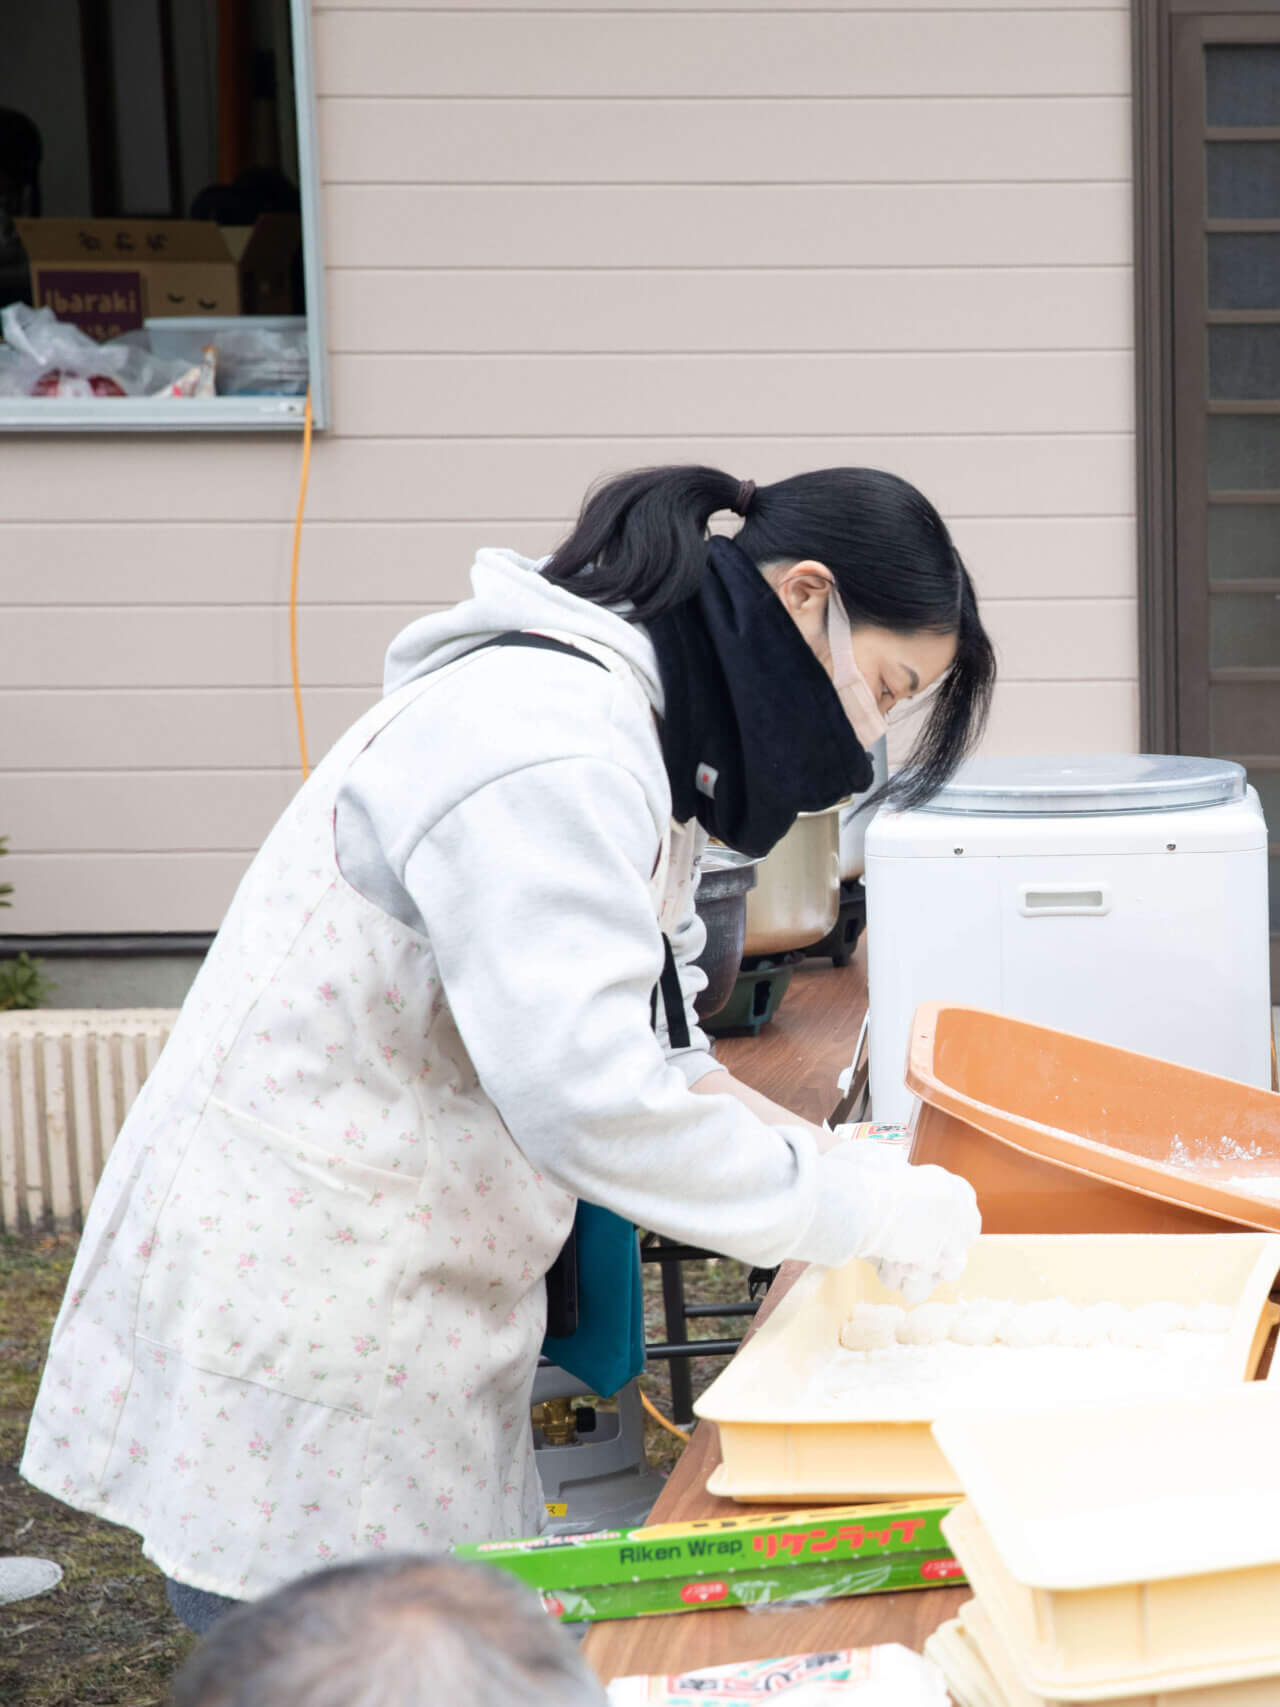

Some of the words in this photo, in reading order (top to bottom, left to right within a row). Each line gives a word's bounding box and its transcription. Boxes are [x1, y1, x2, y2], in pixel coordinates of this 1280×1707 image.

[45, 288, 137, 314] Ibaraki
[753, 1518, 926, 1558] リケンラップ
[620, 1545, 681, 1564] Riken
[688, 1539, 743, 1558] Wrap
